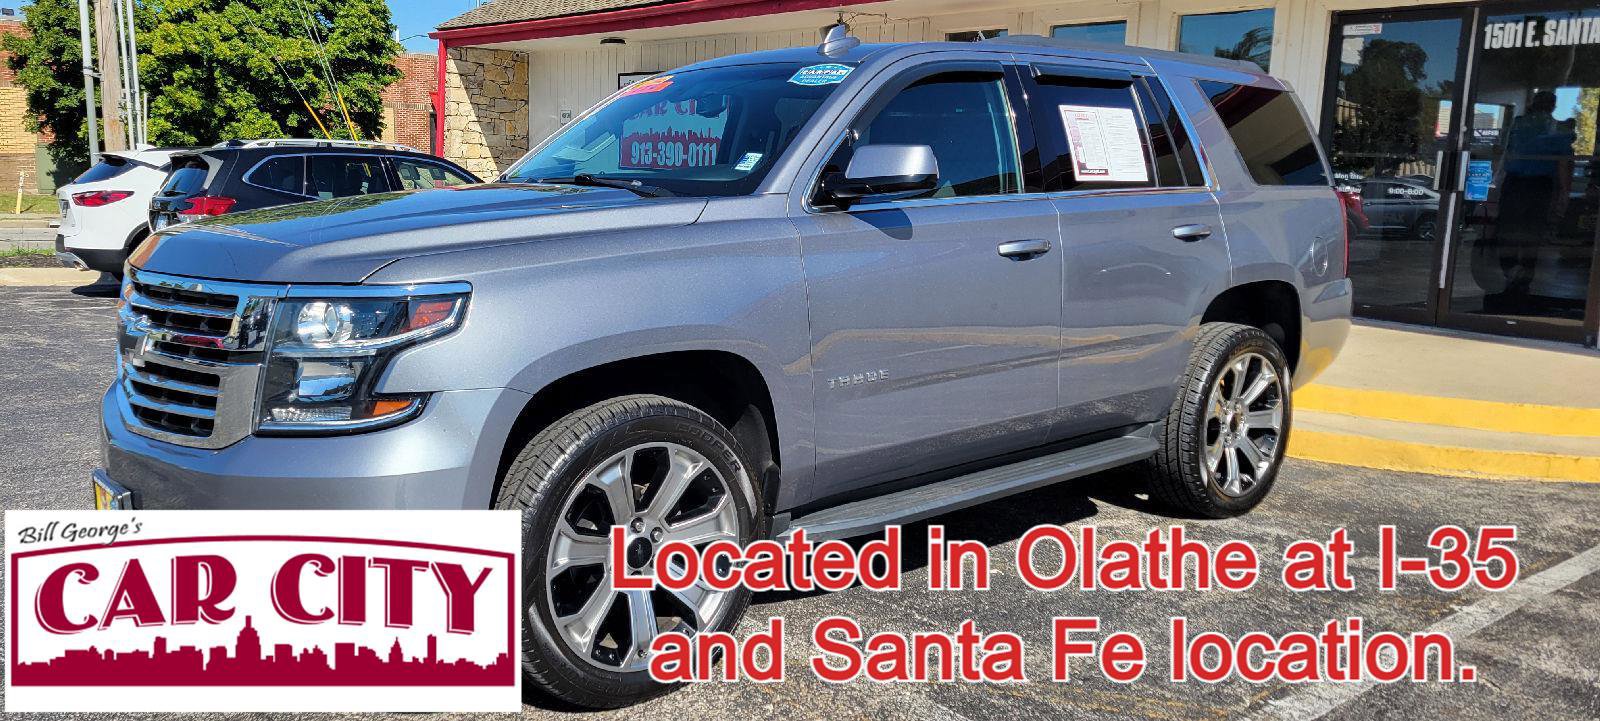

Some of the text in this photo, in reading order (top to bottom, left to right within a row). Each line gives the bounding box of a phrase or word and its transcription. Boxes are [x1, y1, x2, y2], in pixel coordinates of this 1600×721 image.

[1484, 17, 1600, 49] 1501 E. SANTA
[631, 141, 717, 167] 913-390-0111
[828, 368, 889, 389] TAHOE
